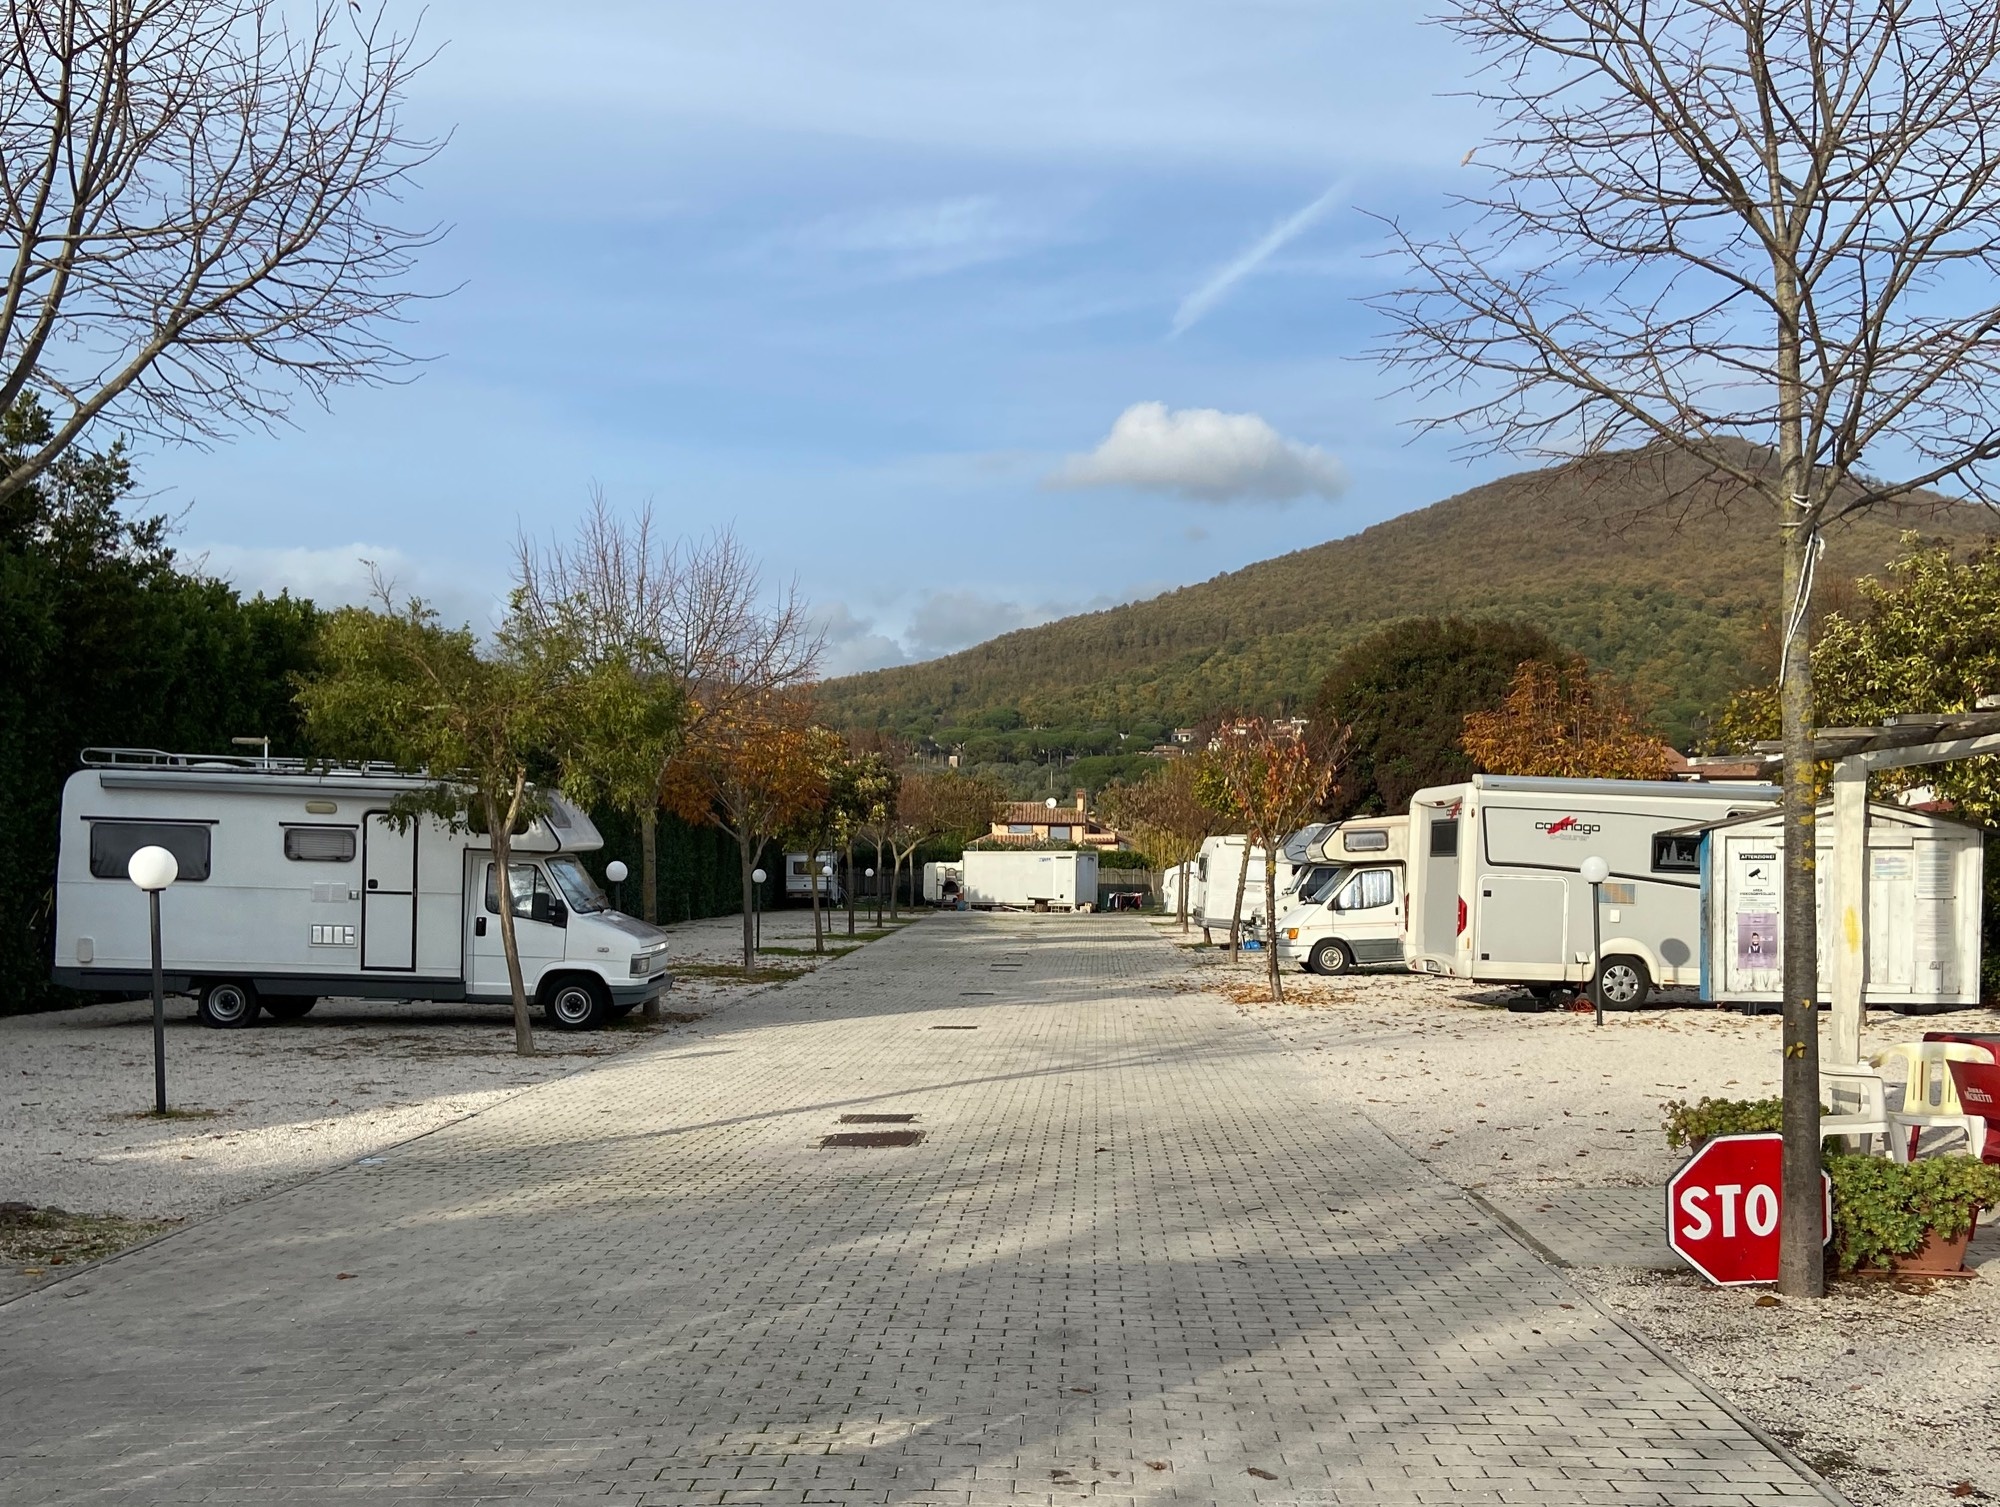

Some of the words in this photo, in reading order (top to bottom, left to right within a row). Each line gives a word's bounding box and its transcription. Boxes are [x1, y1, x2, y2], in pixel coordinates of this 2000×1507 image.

[1535, 821, 1601, 835] carthago
[1964, 1091, 1993, 1103] MORETTI
[1680, 1184, 1778, 1240] STO
